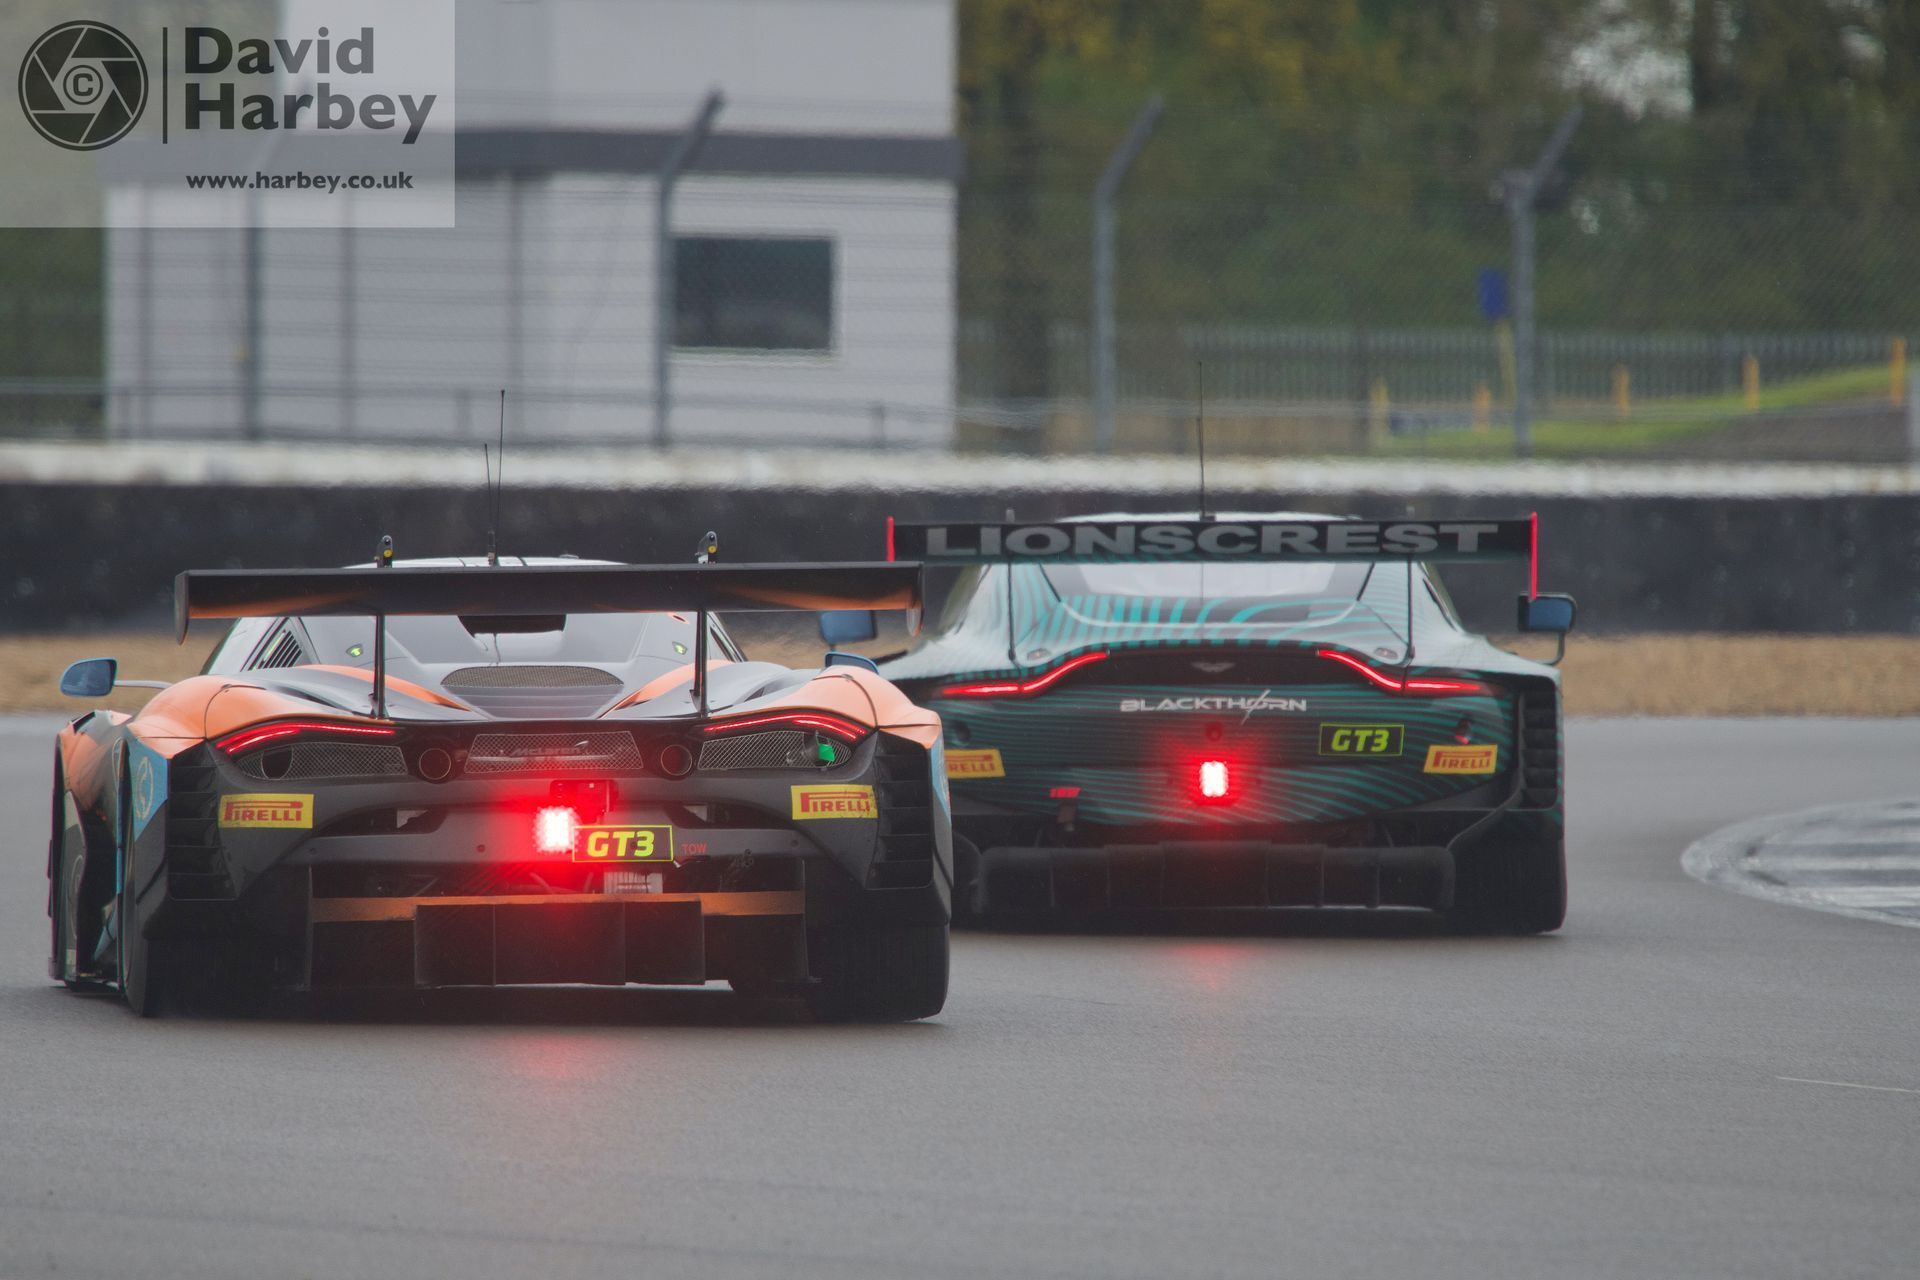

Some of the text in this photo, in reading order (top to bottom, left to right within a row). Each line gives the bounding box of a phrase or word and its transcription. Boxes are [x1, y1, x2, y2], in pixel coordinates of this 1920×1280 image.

[926, 524, 1498, 555] LIONSCREST
[1331, 729, 1389, 752] GT3
[945, 754, 996, 773] RELLI
[1432, 750, 1492, 769] PIRELLI
[223, 801, 304, 822] PIRELLI
[800, 791, 871, 813] PIRELLI
[587, 830, 655, 857] GT3
[682, 843, 708, 854] TOW
